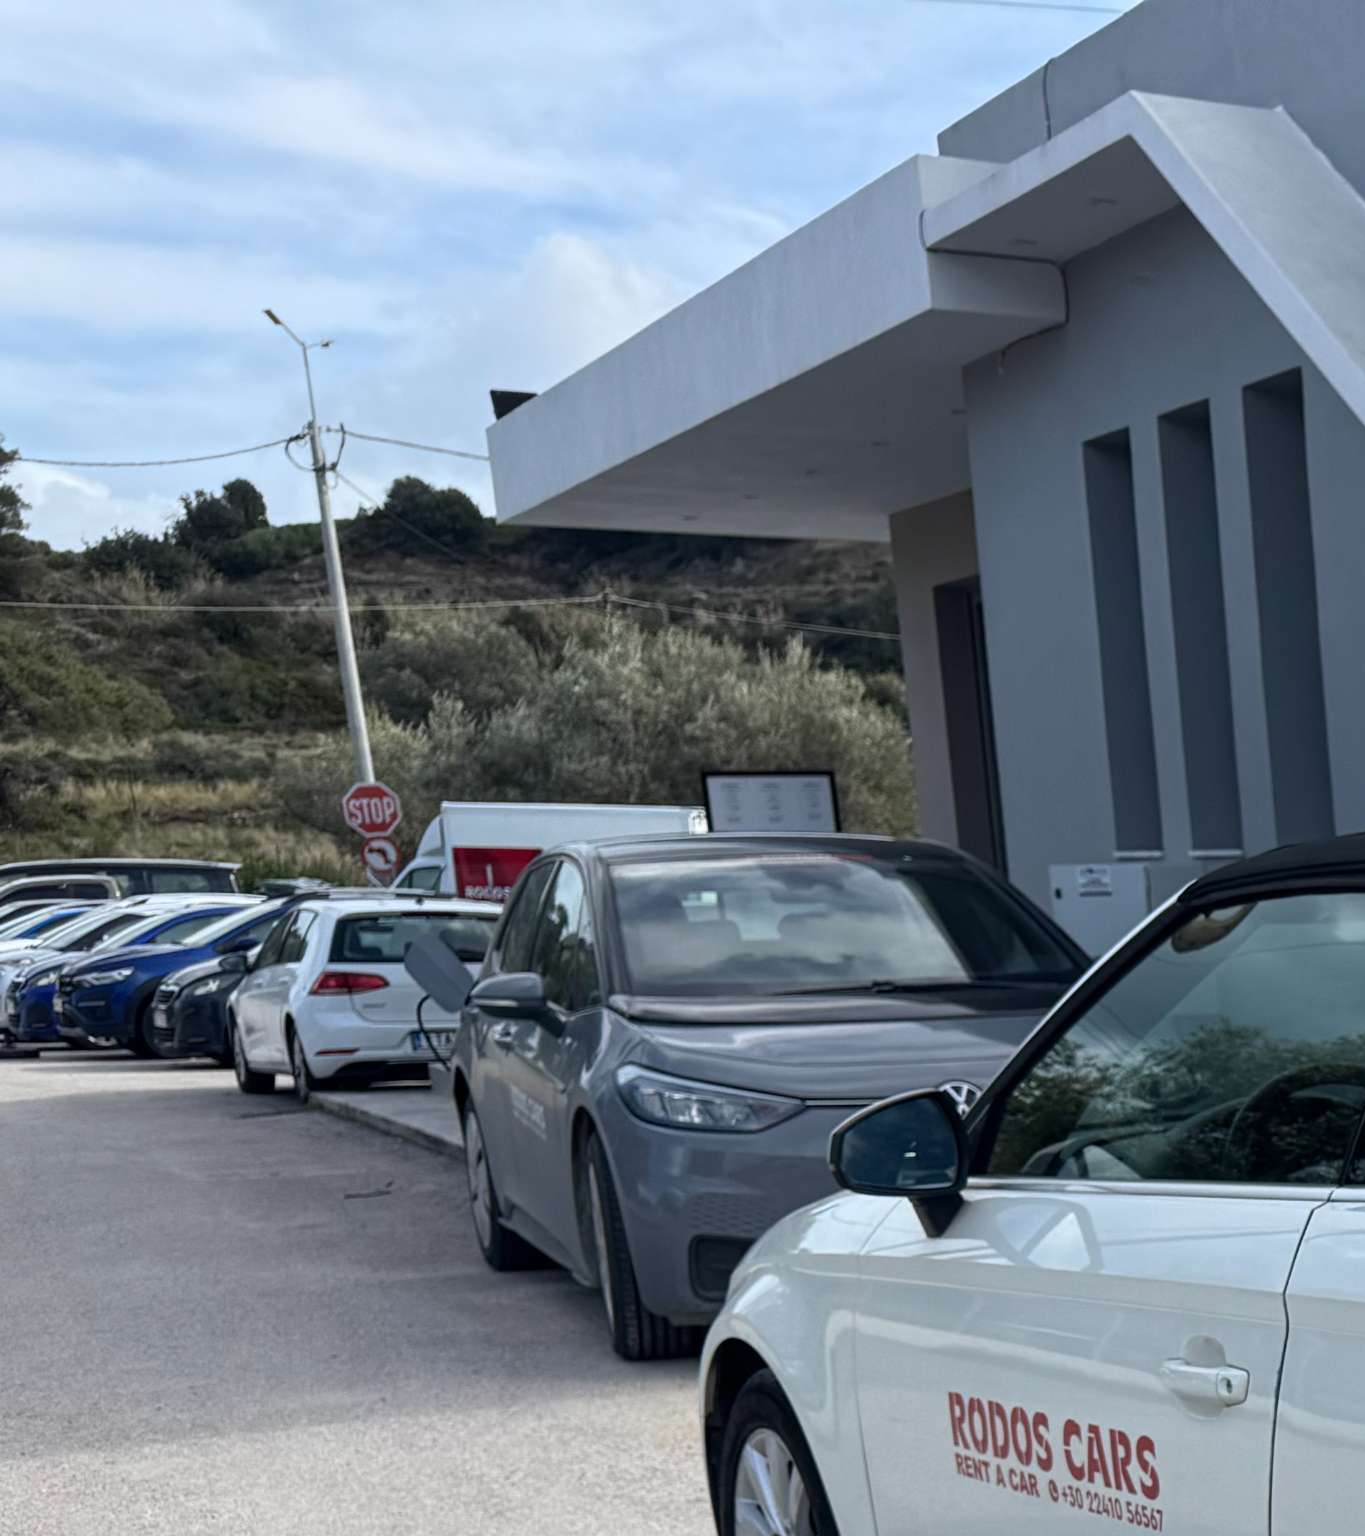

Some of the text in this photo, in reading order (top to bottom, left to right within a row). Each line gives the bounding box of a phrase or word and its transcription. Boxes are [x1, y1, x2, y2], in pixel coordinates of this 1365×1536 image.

[349, 797, 395, 825] STOP
[948, 1392, 1160, 1500] RODOS CARS
[954, 1452, 1163, 1532] RENT A CAR +30 22410 56567
